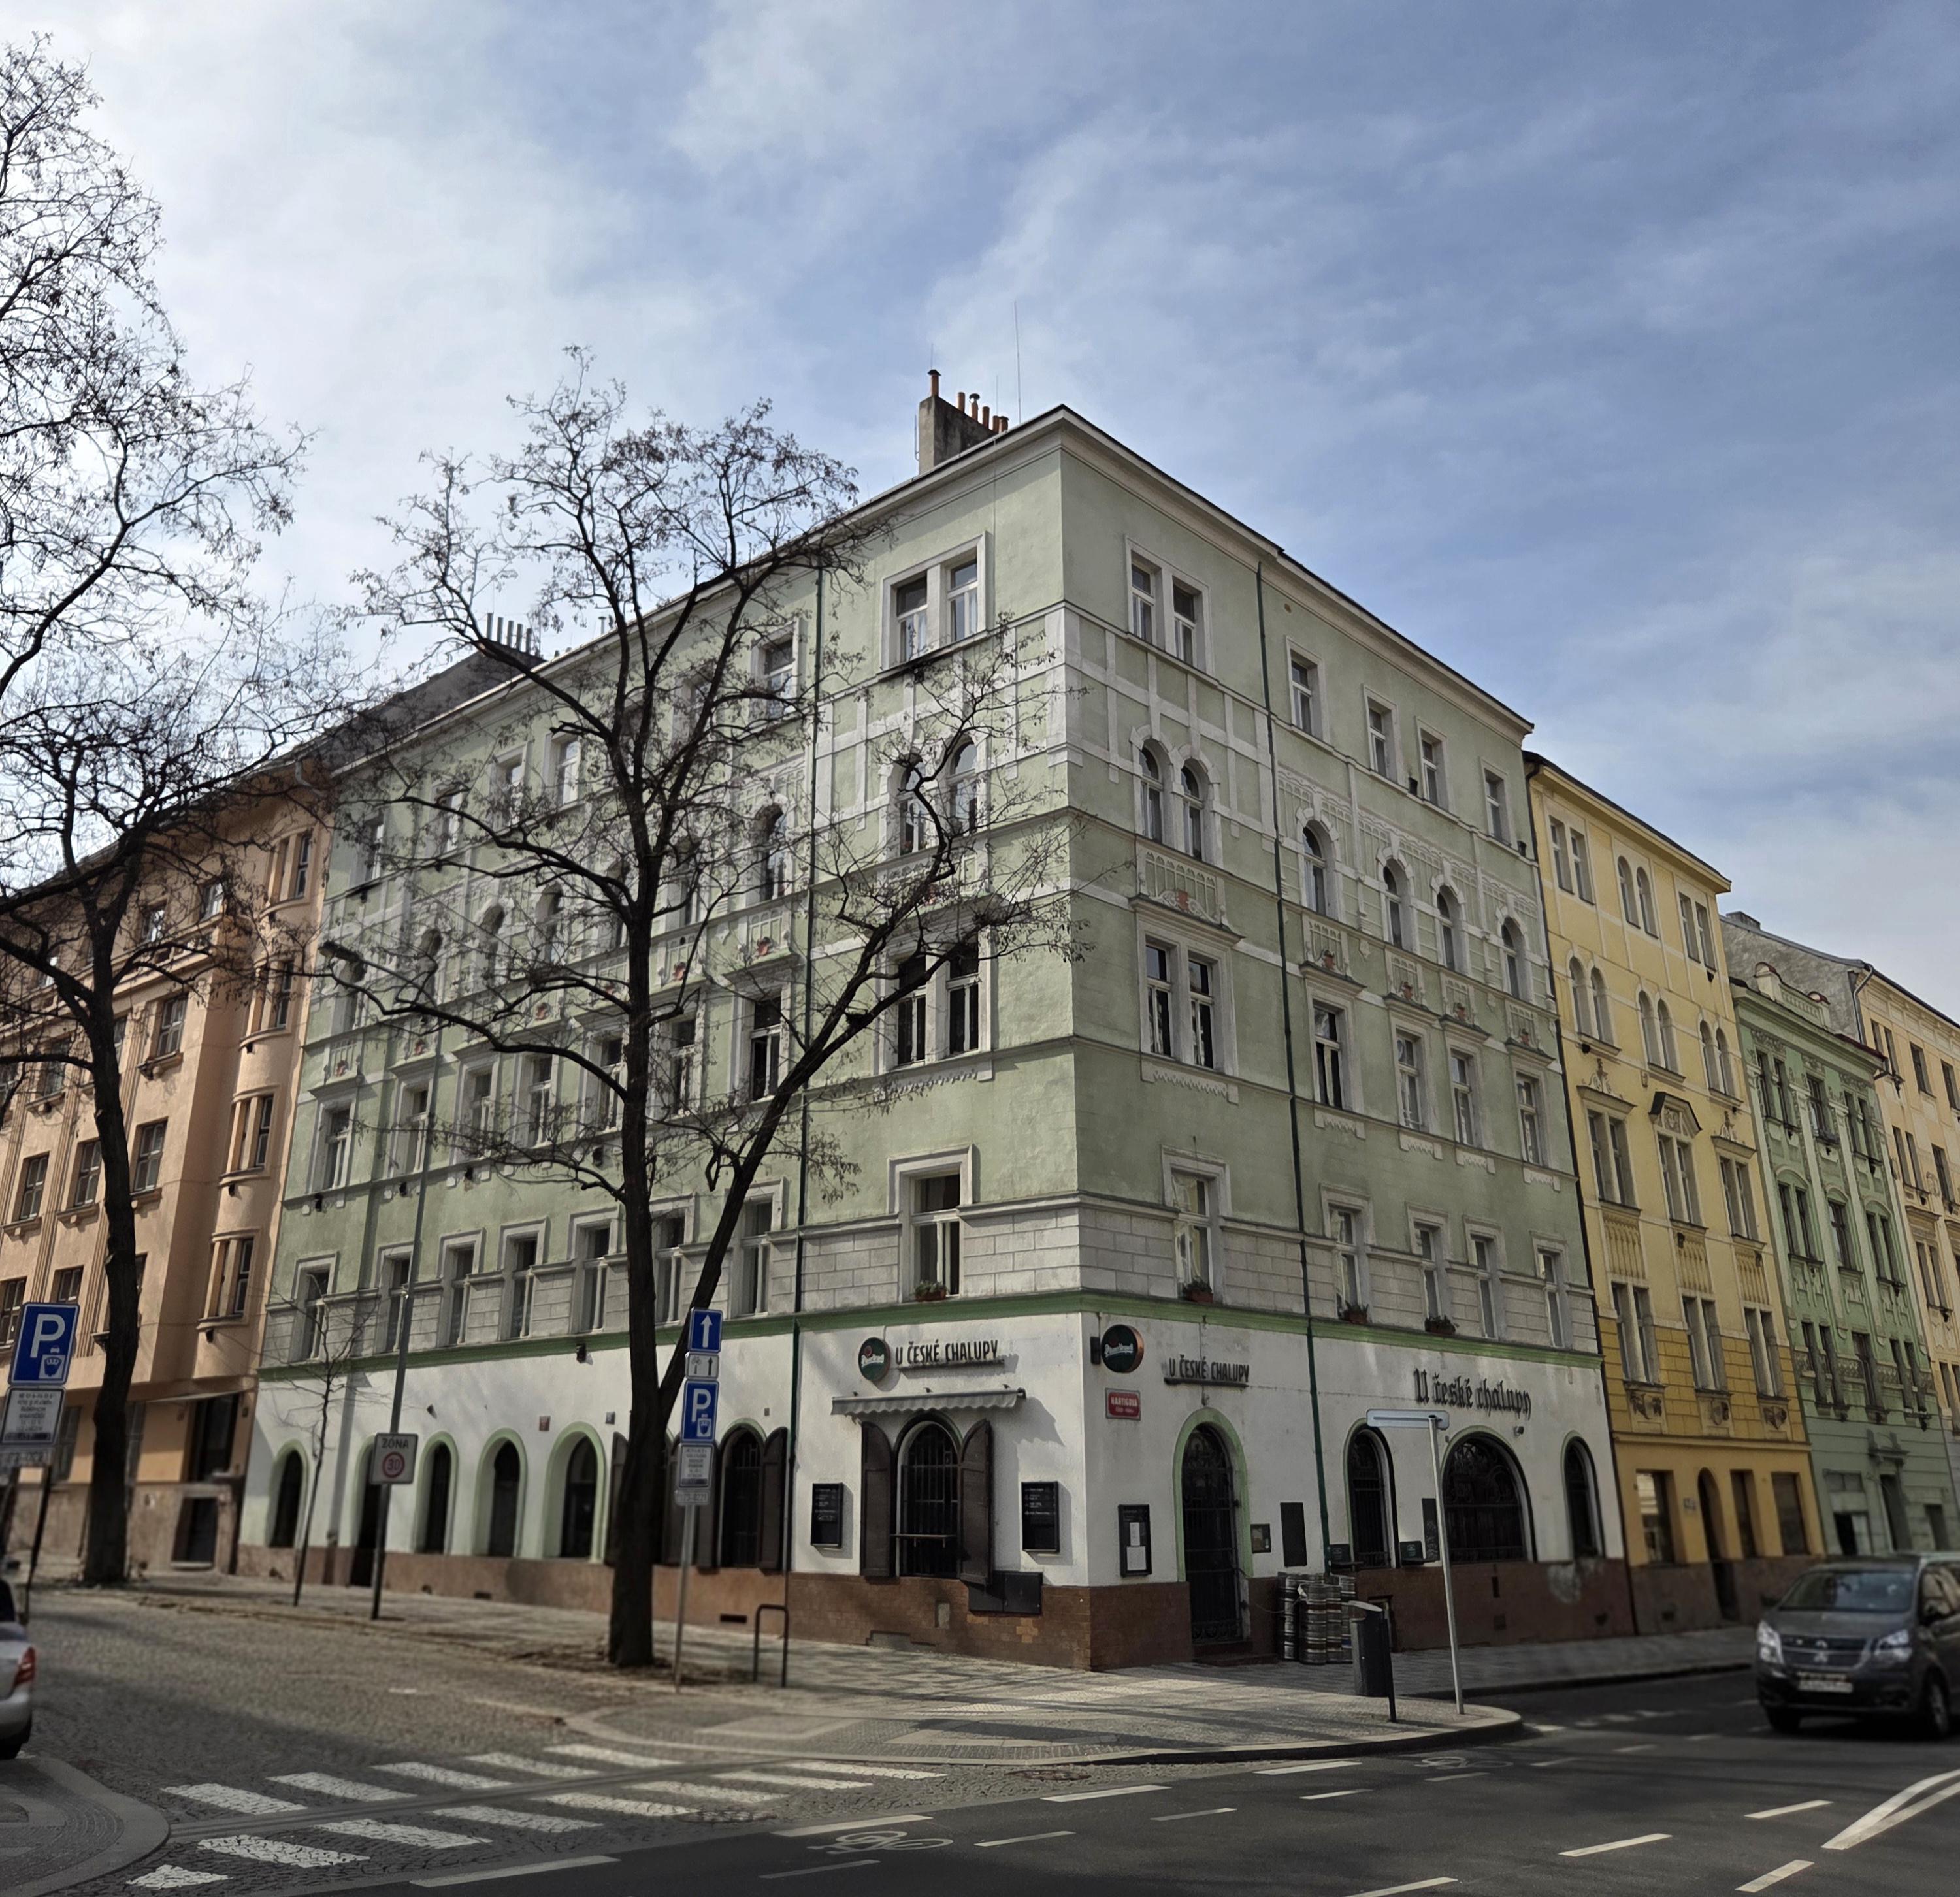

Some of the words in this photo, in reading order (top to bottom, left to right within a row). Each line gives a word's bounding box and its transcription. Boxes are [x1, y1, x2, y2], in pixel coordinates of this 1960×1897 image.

[29, 1313, 65, 1358] P
[895, 1346, 904, 1365] U
[907, 1338, 940, 1365] ČESKÉ
[945, 1339, 998, 1362] CHALUPY
[1169, 1357, 1175, 1377] U
[1179, 1354, 1207, 1380] ČESKÉ
[1211, 1361, 1250, 1382] CHALUPY
[691, 1388, 711, 1423] P
[1413, 1367, 1429, 1404] U
[1431, 1372, 1473, 1409] české
[1475, 1378, 1531, 1421] chalupy
[387, 1459, 401, 1472] 30
